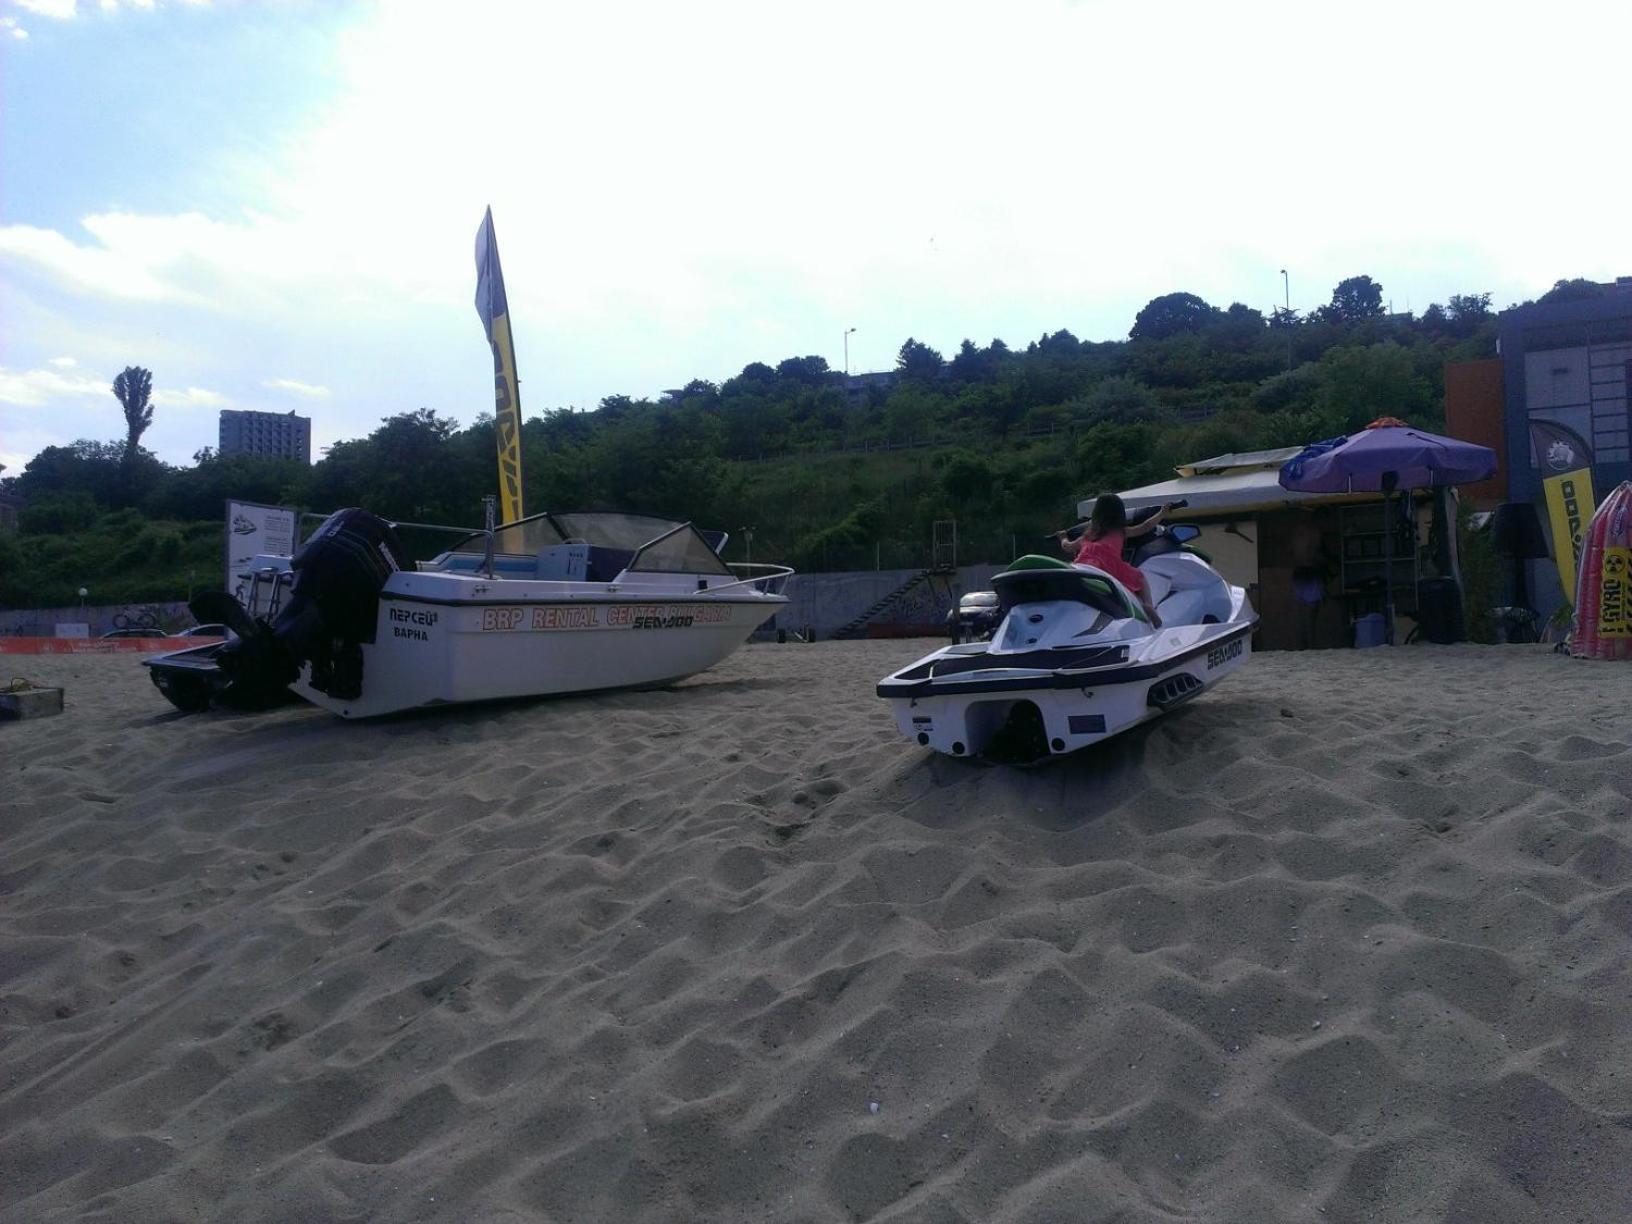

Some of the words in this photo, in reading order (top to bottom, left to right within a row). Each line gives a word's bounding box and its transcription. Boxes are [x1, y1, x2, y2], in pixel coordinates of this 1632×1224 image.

[483, 607, 524, 630] BRP
[532, 606, 598, 628] RENTAL
[394, 627, 428, 641] ВАРНА
